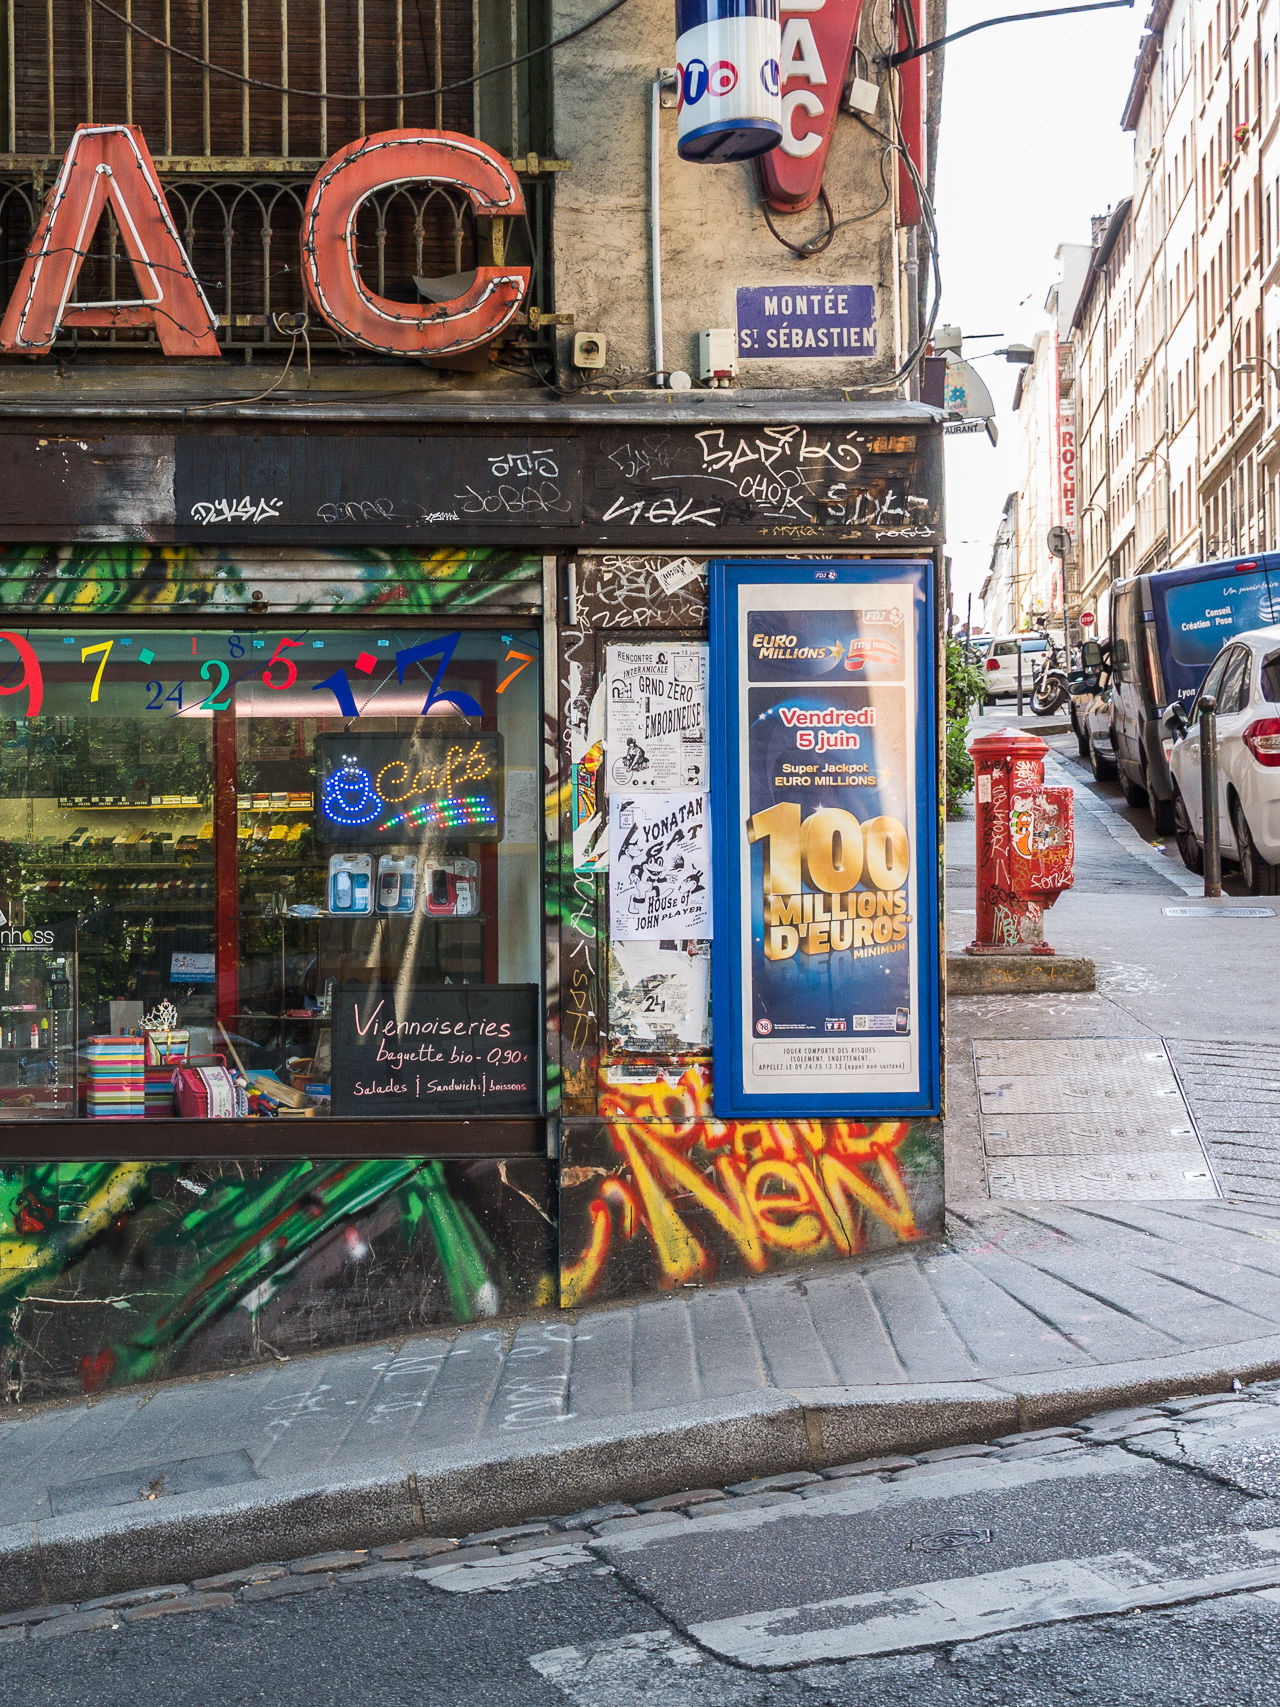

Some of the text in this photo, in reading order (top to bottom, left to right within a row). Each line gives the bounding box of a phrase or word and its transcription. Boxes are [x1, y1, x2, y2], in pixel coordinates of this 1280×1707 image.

[764, 288, 849, 316] MONTÉE
[766, 321, 875, 349] SÉBASTIEN
[945, 425, 978, 435] AURANT
[1062, 431, 1076, 516] ROCHE
[1181, 617, 1233, 631] Création Pose
[1205, 606, 1231, 618] Conseil
[190, 637, 198, 655] 1
[227, 635, 245, 658] 8
[752, 633, 798, 649] EURO
[262, 637, 305, 690] 5
[618, 650, 653, 662] RENCONTRE
[81, 639, 114, 703] 7
[495, 650, 537, 694] 7
[623, 666, 668, 678] INTERAMICALE
[145, 680, 184, 710] 24
[200, 659, 232, 711] 2
[639, 675, 694, 703] GRND ZERO
[1178, 688, 1196, 699] Lyon
[644, 703, 701, 740] EMBOBINEUSE
[781, 708, 875, 726] Vendredi
[798, 732, 859, 752] 5 juin
[376, 742, 491, 802] Café
[775, 775, 877, 786] EURO MILLIONS
[782, 763, 869, 774] Super Jackpot
[642, 797, 703, 842] YONATAN
[645, 824, 704, 858] GAT
[747, 801, 910, 895] 100
[647, 895, 678, 914] HOUSE
[768, 889, 908, 926] MILLIONS
[635, 906, 702, 931] JOHN PLAYER
[853, 942, 906, 960] MINIMUM
[643, 995, 666, 1013] 24
[354, 1000, 511, 1038] Viennoiseries
[376, 1038, 445, 1069] baguette
[448, 1046, 473, 1064] bio
[353, 1077, 408, 1096] Salades
[489, 1079, 527, 1092] boissons
